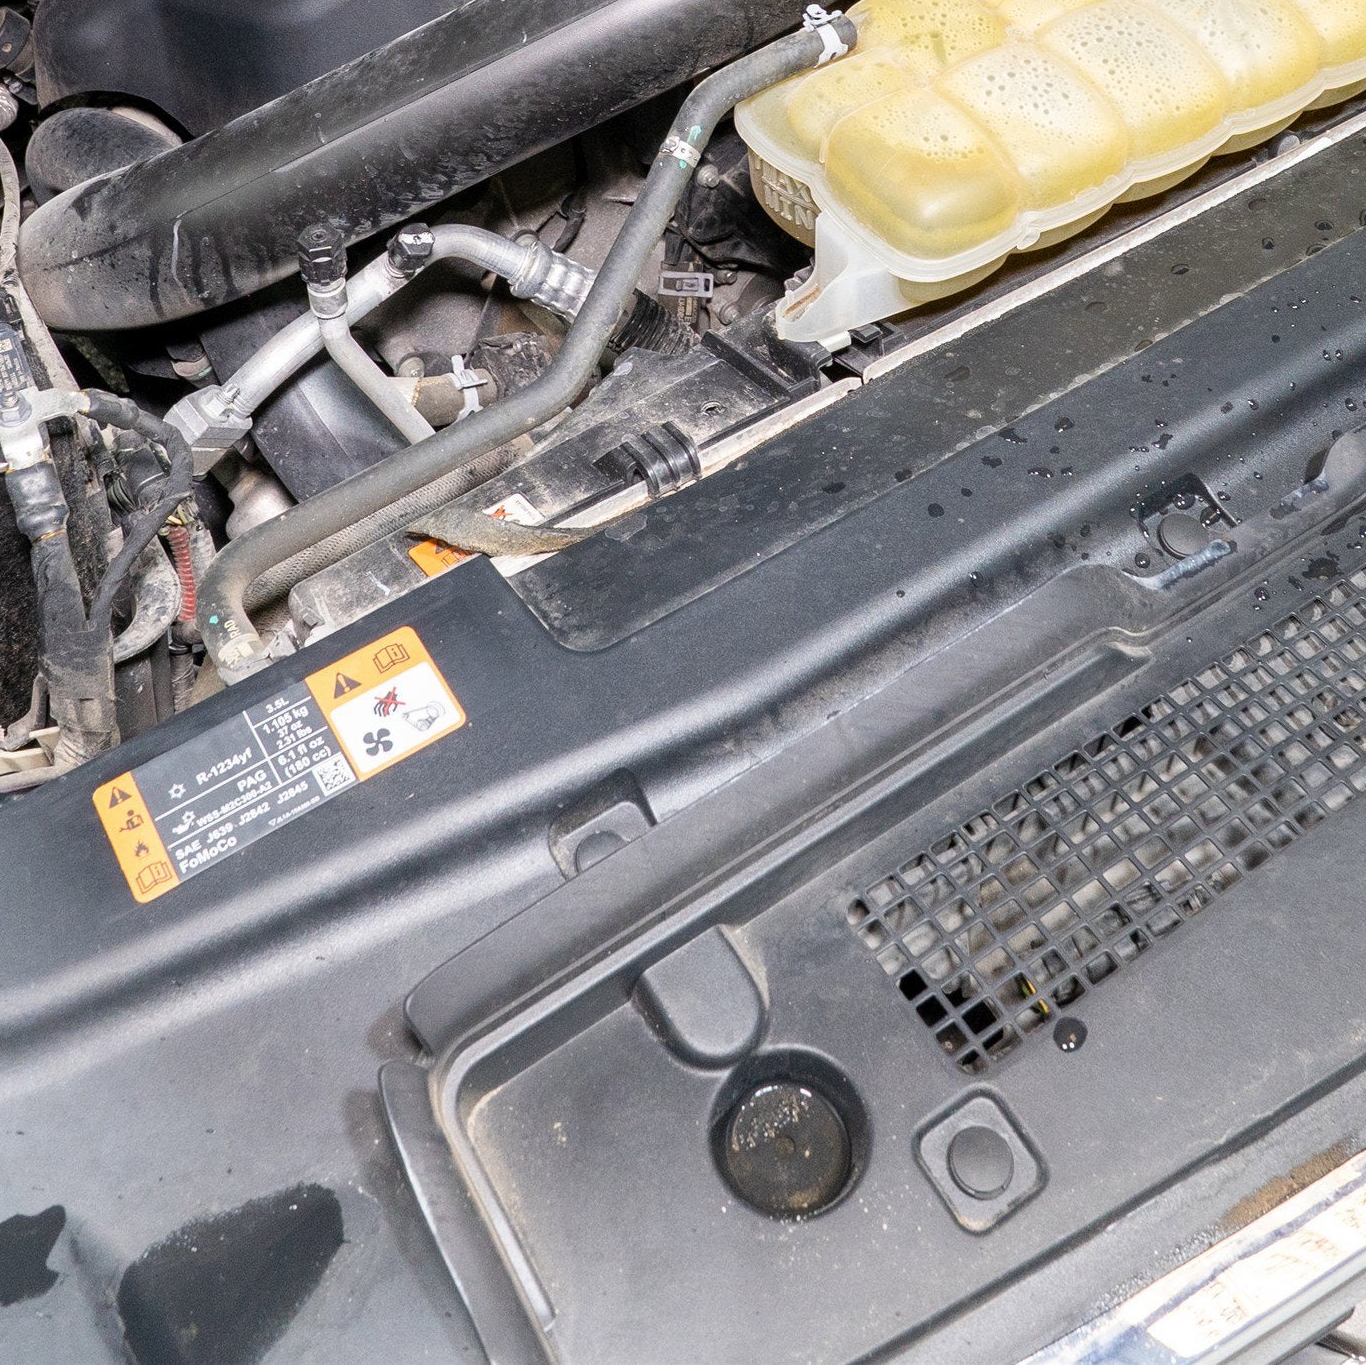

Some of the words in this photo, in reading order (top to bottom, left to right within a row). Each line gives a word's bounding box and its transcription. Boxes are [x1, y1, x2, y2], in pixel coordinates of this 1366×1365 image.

[763, 184, 814, 230] MIN
[223, 618, 241, 638] RAD
[261, 712, 293, 735] 1.105
[290, 703, 309, 721] kg
[264, 695, 290, 714] 3.5L
[275, 732, 298, 750] 2.31
[295, 724, 313, 738] lbs
[276, 726, 291, 738] 37
[290, 720, 303, 731] oz
[194, 747, 254, 786] R-1234yf
[277, 750, 297, 766] 6.1
[295, 743, 308, 755] fl
[307, 736, 324, 750] oz
[283, 756, 313, 778] (180
[310, 744, 333, 764] cc)
[235, 769, 268, 793] PAG
[173, 839, 202, 860] SAE
[203, 821, 234, 844] J639
[236, 801, 271, 826] J2842
[179, 834, 238, 875] FoMoCo
